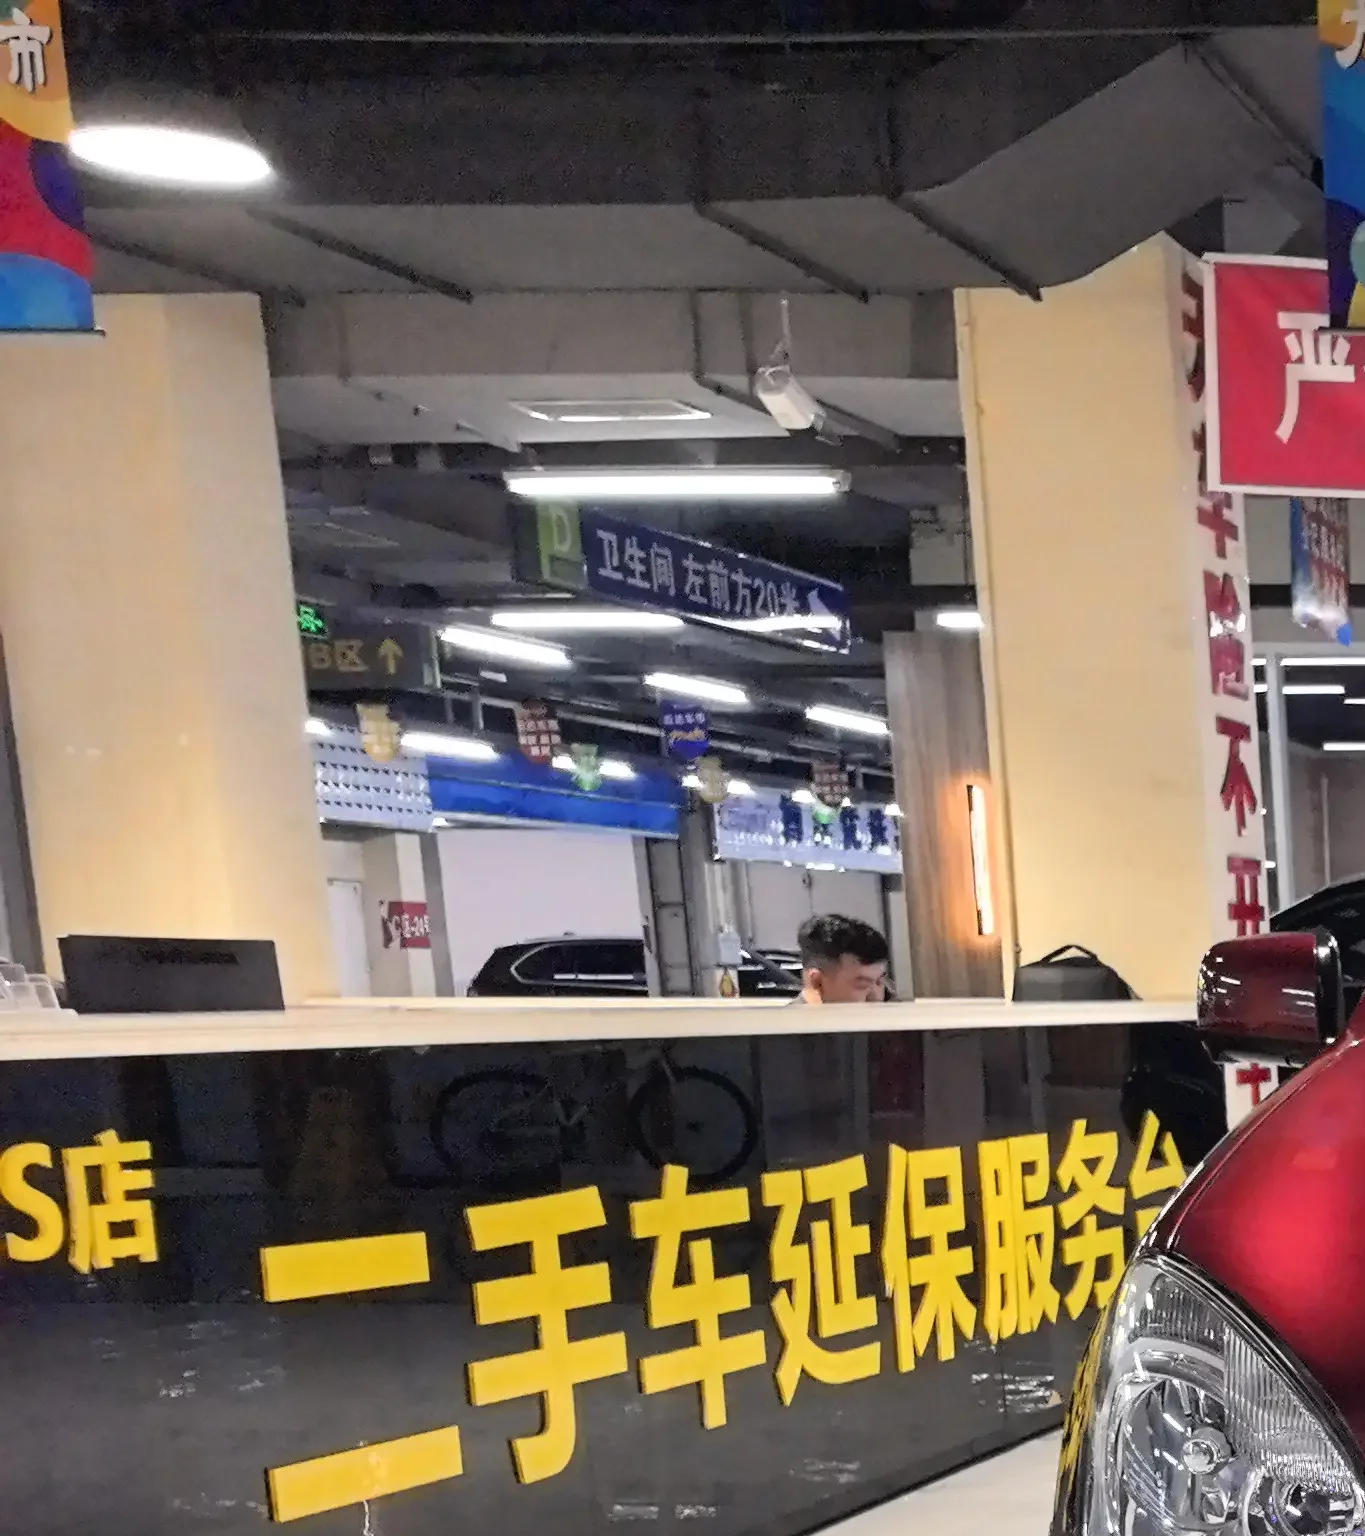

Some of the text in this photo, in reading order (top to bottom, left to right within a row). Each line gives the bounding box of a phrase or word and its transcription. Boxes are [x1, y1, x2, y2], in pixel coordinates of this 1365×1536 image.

[0, 7, 51, 93] 市
[596, 528, 800, 618] 卫生间 左前方20米
[0, 1128, 159, 1275] S店
